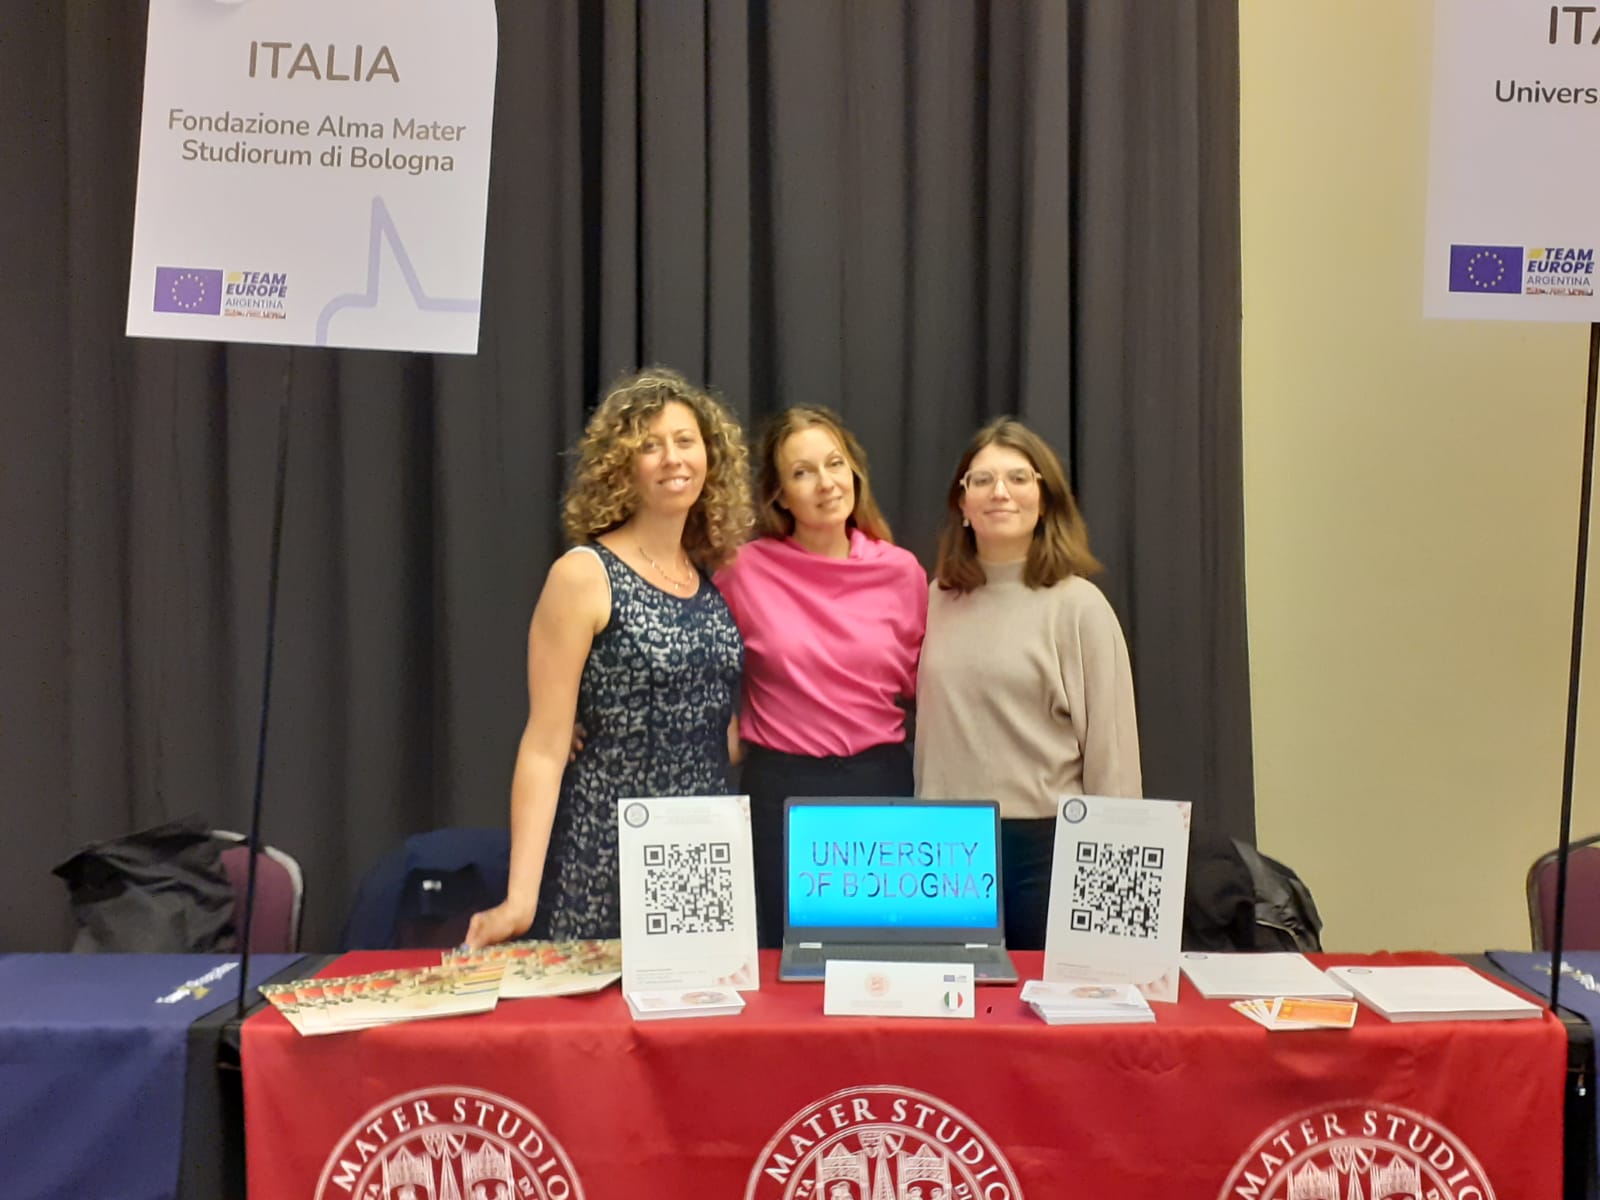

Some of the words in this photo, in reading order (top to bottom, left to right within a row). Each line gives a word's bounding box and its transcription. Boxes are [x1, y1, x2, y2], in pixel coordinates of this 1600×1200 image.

[1549, 5, 1600, 45] IT
[248, 40, 400, 83] ITALIA
[168, 109, 310, 137] Fondazione
[316, 115, 384, 139] Alma
[392, 118, 466, 143] Mater
[181, 139, 312, 167] Studiorum
[319, 144, 342, 168] di
[350, 147, 455, 176] Bologna
[1527, 260, 1595, 274] EUROPE
[1544, 247, 1594, 261] TEAM
[226, 283, 288, 298] EUROPE
[242, 271, 288, 285] TEAM
[1526, 275, 1591, 287] ARGENTINA
[225, 297, 284, 310] ARGENTINA
[812, 841, 979, 867] UNIVERSITY
[843, 872, 995, 899] BOLOGNA?
[331, 1099, 438, 1193] MATER
[764, 1098, 878, 1185] MATER
[1235, 1112, 1346, 1200] MATER
